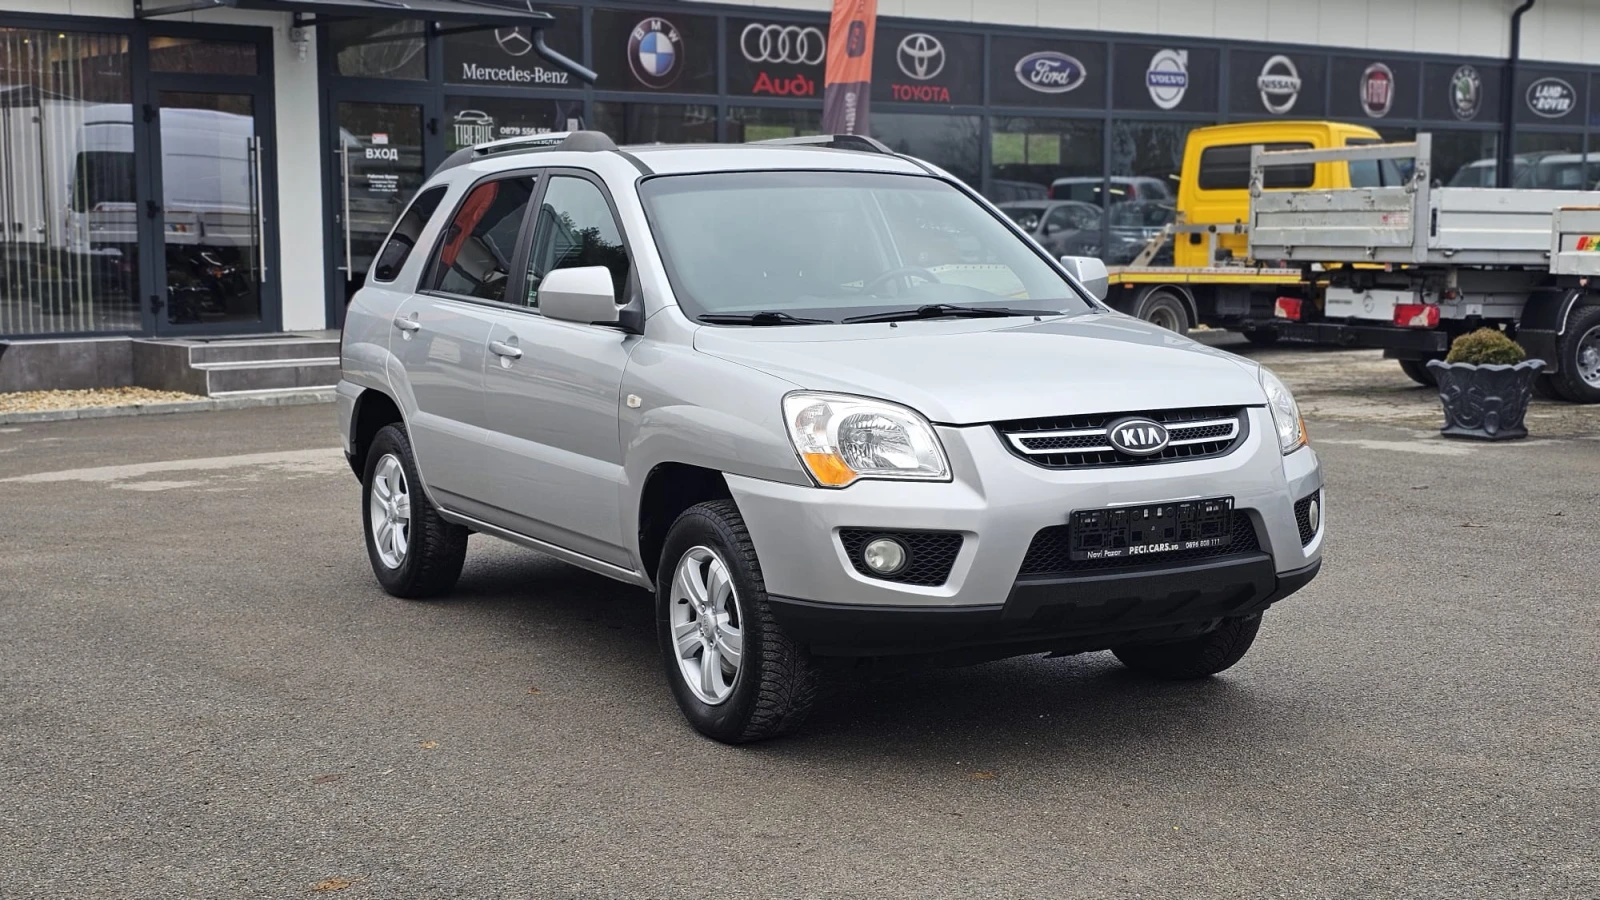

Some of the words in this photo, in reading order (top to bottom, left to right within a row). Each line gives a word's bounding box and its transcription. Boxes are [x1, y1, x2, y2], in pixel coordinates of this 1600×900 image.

[634, 20, 680, 43] BMW
[462, 63, 568, 84] Mercedes-Benz
[1031, 59, 1070, 85] Ford
[1150, 74, 1186, 85] VOLVO
[753, 72, 814, 95] Audi
[1261, 79, 1298, 91] NISSAN
[892, 84, 951, 102] TOYOTA
[1536, 98, 1570, 110] ROVER
[500, 126, 520, 135] 0879
[366, 148, 398, 160] ВХОД
[1120, 427, 1161, 447] KIA
